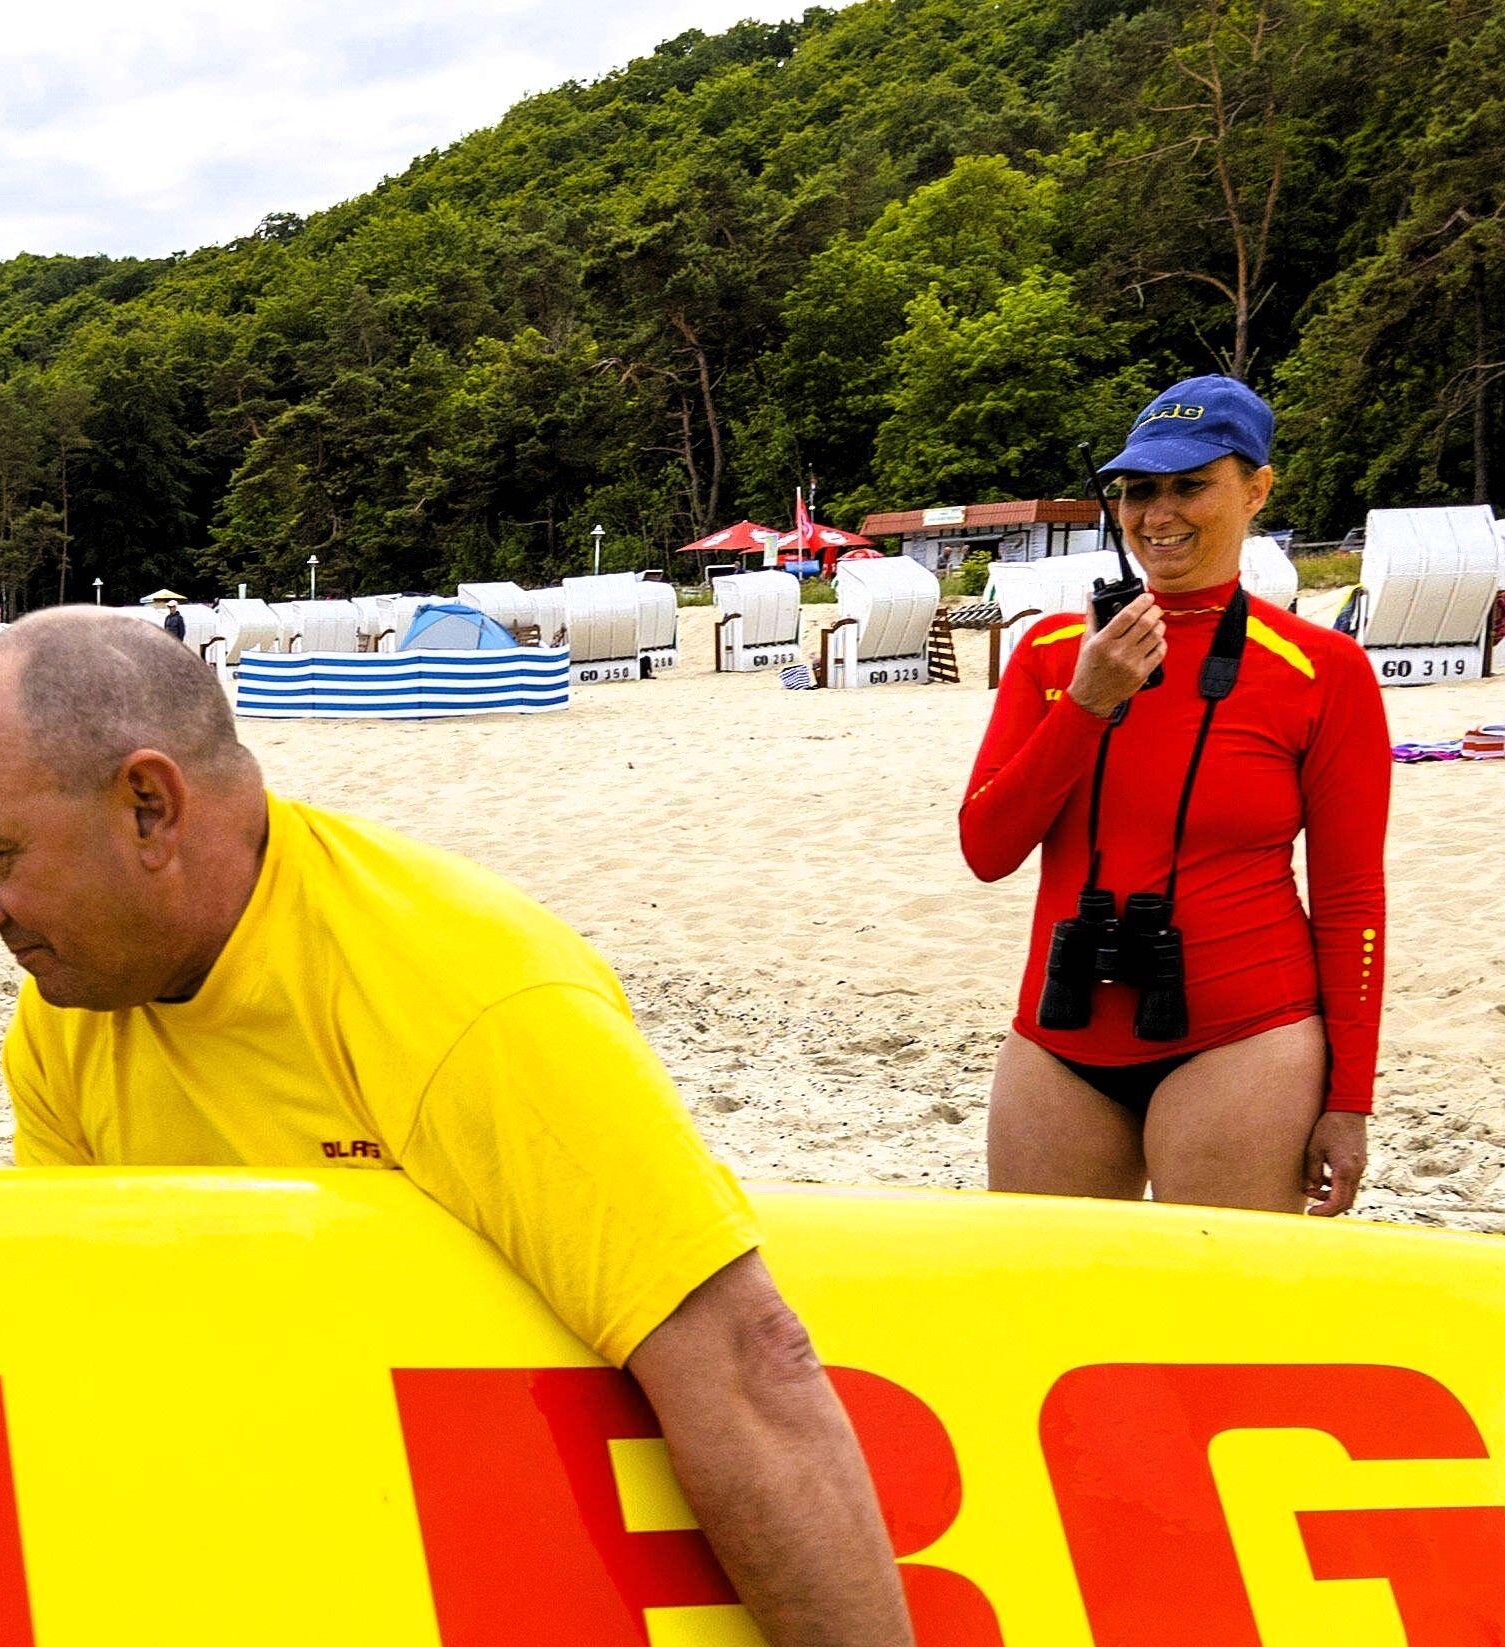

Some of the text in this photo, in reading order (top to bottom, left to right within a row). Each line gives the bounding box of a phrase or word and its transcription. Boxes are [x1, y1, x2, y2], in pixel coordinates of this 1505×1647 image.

[753, 655, 769, 667] GO
[1382, 659, 1466, 678] GO 319
[580, 667, 629, 682] GO 350
[870, 668, 919, 685] GO 329
[321, 1140, 381, 1158] DLRG
